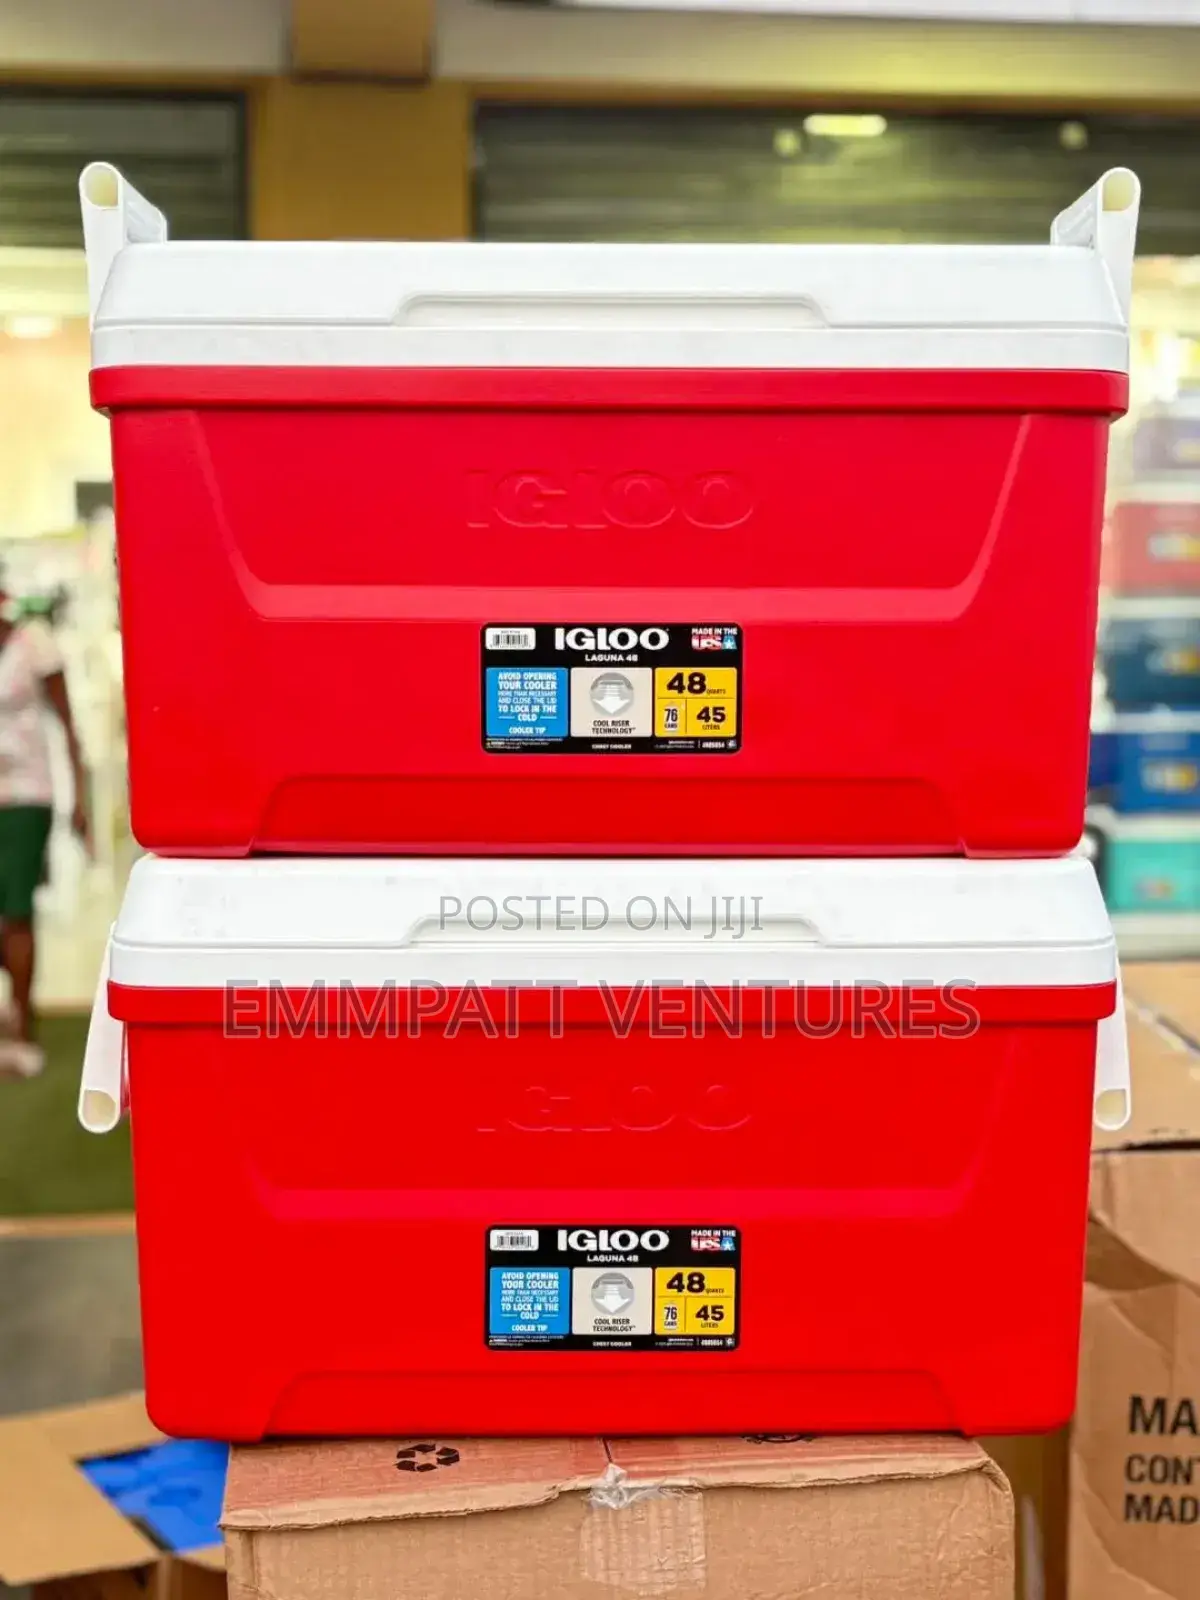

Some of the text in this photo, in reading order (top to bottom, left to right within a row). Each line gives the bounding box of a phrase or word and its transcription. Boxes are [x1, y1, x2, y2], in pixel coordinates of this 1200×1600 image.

[463, 469, 754, 529] IGLOO
[555, 627, 669, 651] IGLOO
[692, 635, 737, 650] USA
[585, 654, 638, 662] LAGUNA 48
[498, 672, 557, 680] AVOID OPENING
[666, 672, 706, 694] 48
[498, 681, 557, 690] YOUR COOLER
[664, 708, 678, 722] 76
[696, 706, 726, 723] 45
[558, 1229, 670, 1251] IGLOO
[691, 1237, 736, 1250] USA
[502, 1280, 559, 1289] YOUR COOLER
[666, 1272, 705, 1293] 48
[501, 1303, 559, 1311] TO LOCK IN THE
[664, 1306, 677, 1320] 76
[696, 1305, 724, 1321] 45
[520, 1312, 539, 1320] COLD
